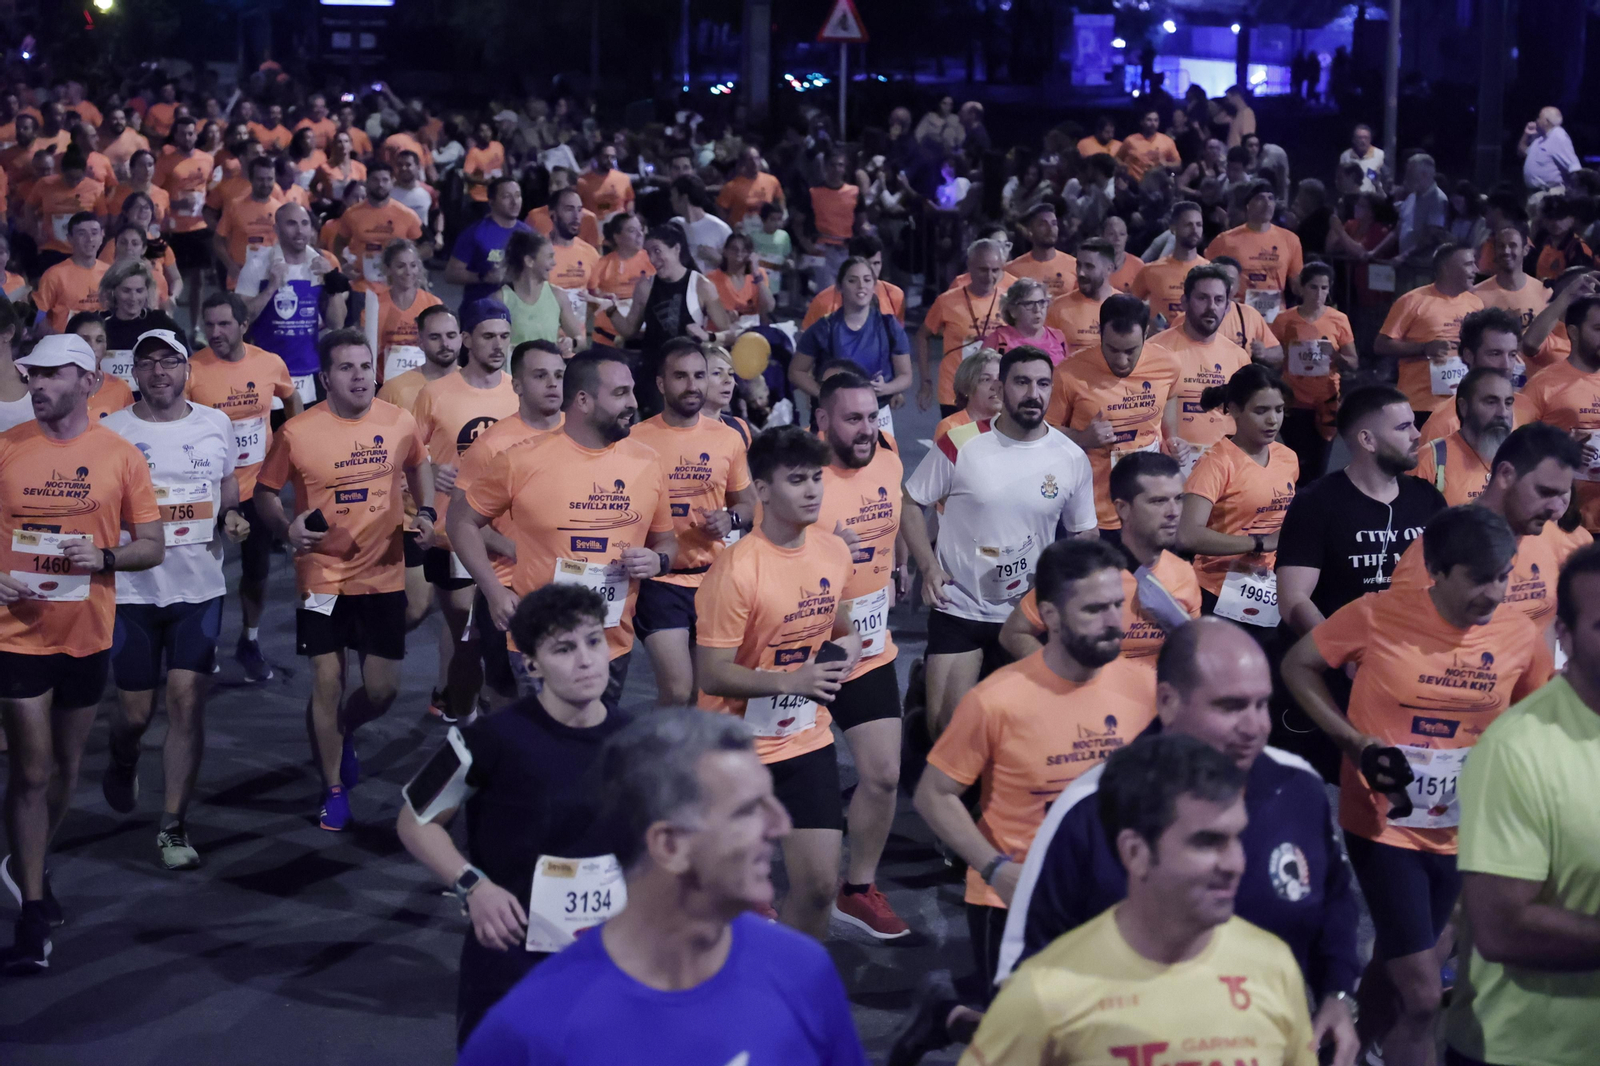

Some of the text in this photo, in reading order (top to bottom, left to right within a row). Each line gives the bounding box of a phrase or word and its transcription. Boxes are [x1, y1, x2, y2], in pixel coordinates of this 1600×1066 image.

[227, 393, 259, 402] NOCTURNA
[1122, 393, 1157, 402] NOCTURNA
[1107, 402, 1139, 412] SEVILLA
[351, 449, 388, 458] NOCTURNA
[334, 457, 368, 469] SEVILLA
[45, 481, 91, 490] NOCTURNA
[23, 488, 64, 498] SEVILLA
[588, 494, 631, 503] NOCTURNA
[169, 504, 195, 520] 756
[569, 502, 608, 510] SEVILLA
[859, 502, 893, 514] NOCTURNA
[845, 513, 877, 527] SEVILLA
[1355, 530, 1399, 543] CITY
[33, 556, 71, 574] 1460
[996, 557, 1028, 578] 7978
[1348, 554, 1388, 568] THE
[1510, 581, 1546, 593] NOCTURNA
[1239, 583, 1278, 607] 19959
[798, 596, 835, 609] NOCTURNA
[783, 609, 815, 624] SEVILLA
[1445, 667, 1498, 680] NOCTURNA
[1417, 675, 1468, 690] SEVILLA
[1414, 775, 1458, 797] 1511
[564, 889, 612, 914] 3134
